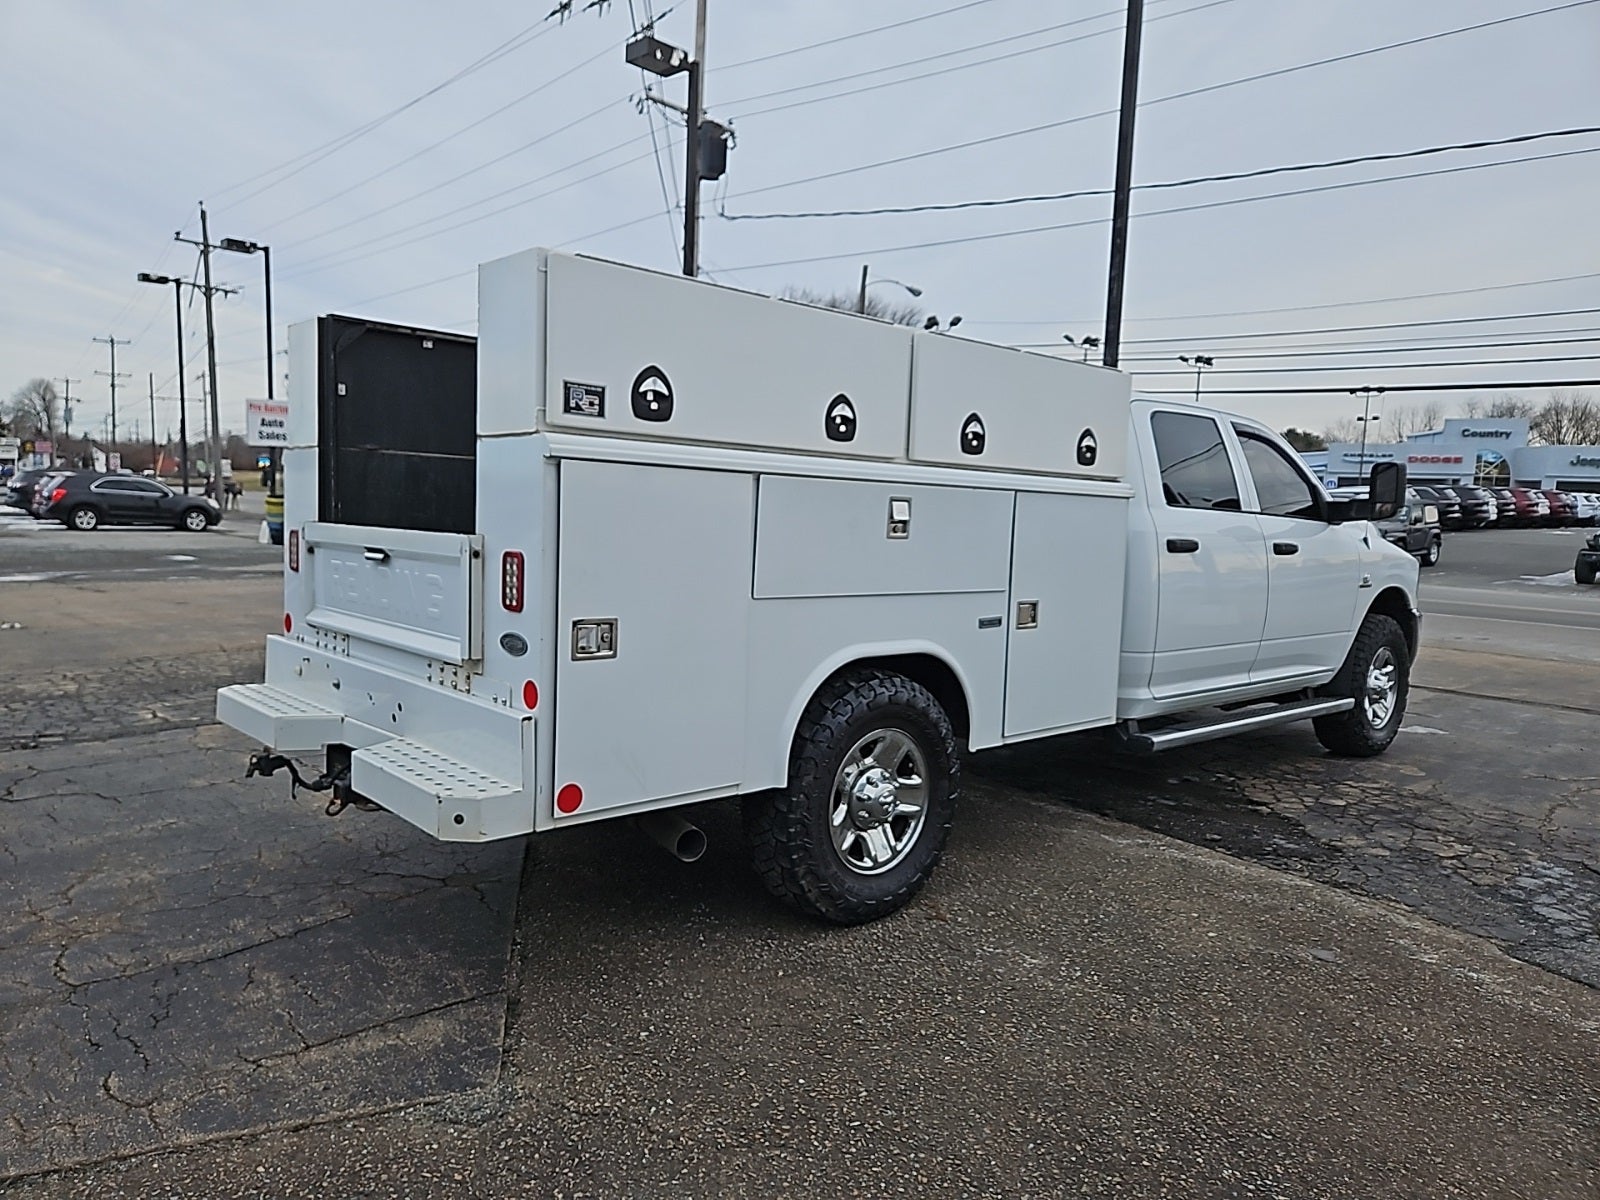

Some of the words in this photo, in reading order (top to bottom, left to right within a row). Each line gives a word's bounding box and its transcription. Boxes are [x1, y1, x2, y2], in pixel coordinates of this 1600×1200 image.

[260, 417, 284, 428] Auto
[258, 430, 288, 441] Sales
[1461, 428, 1512, 440] Country
[1408, 455, 1463, 464] DODGE
